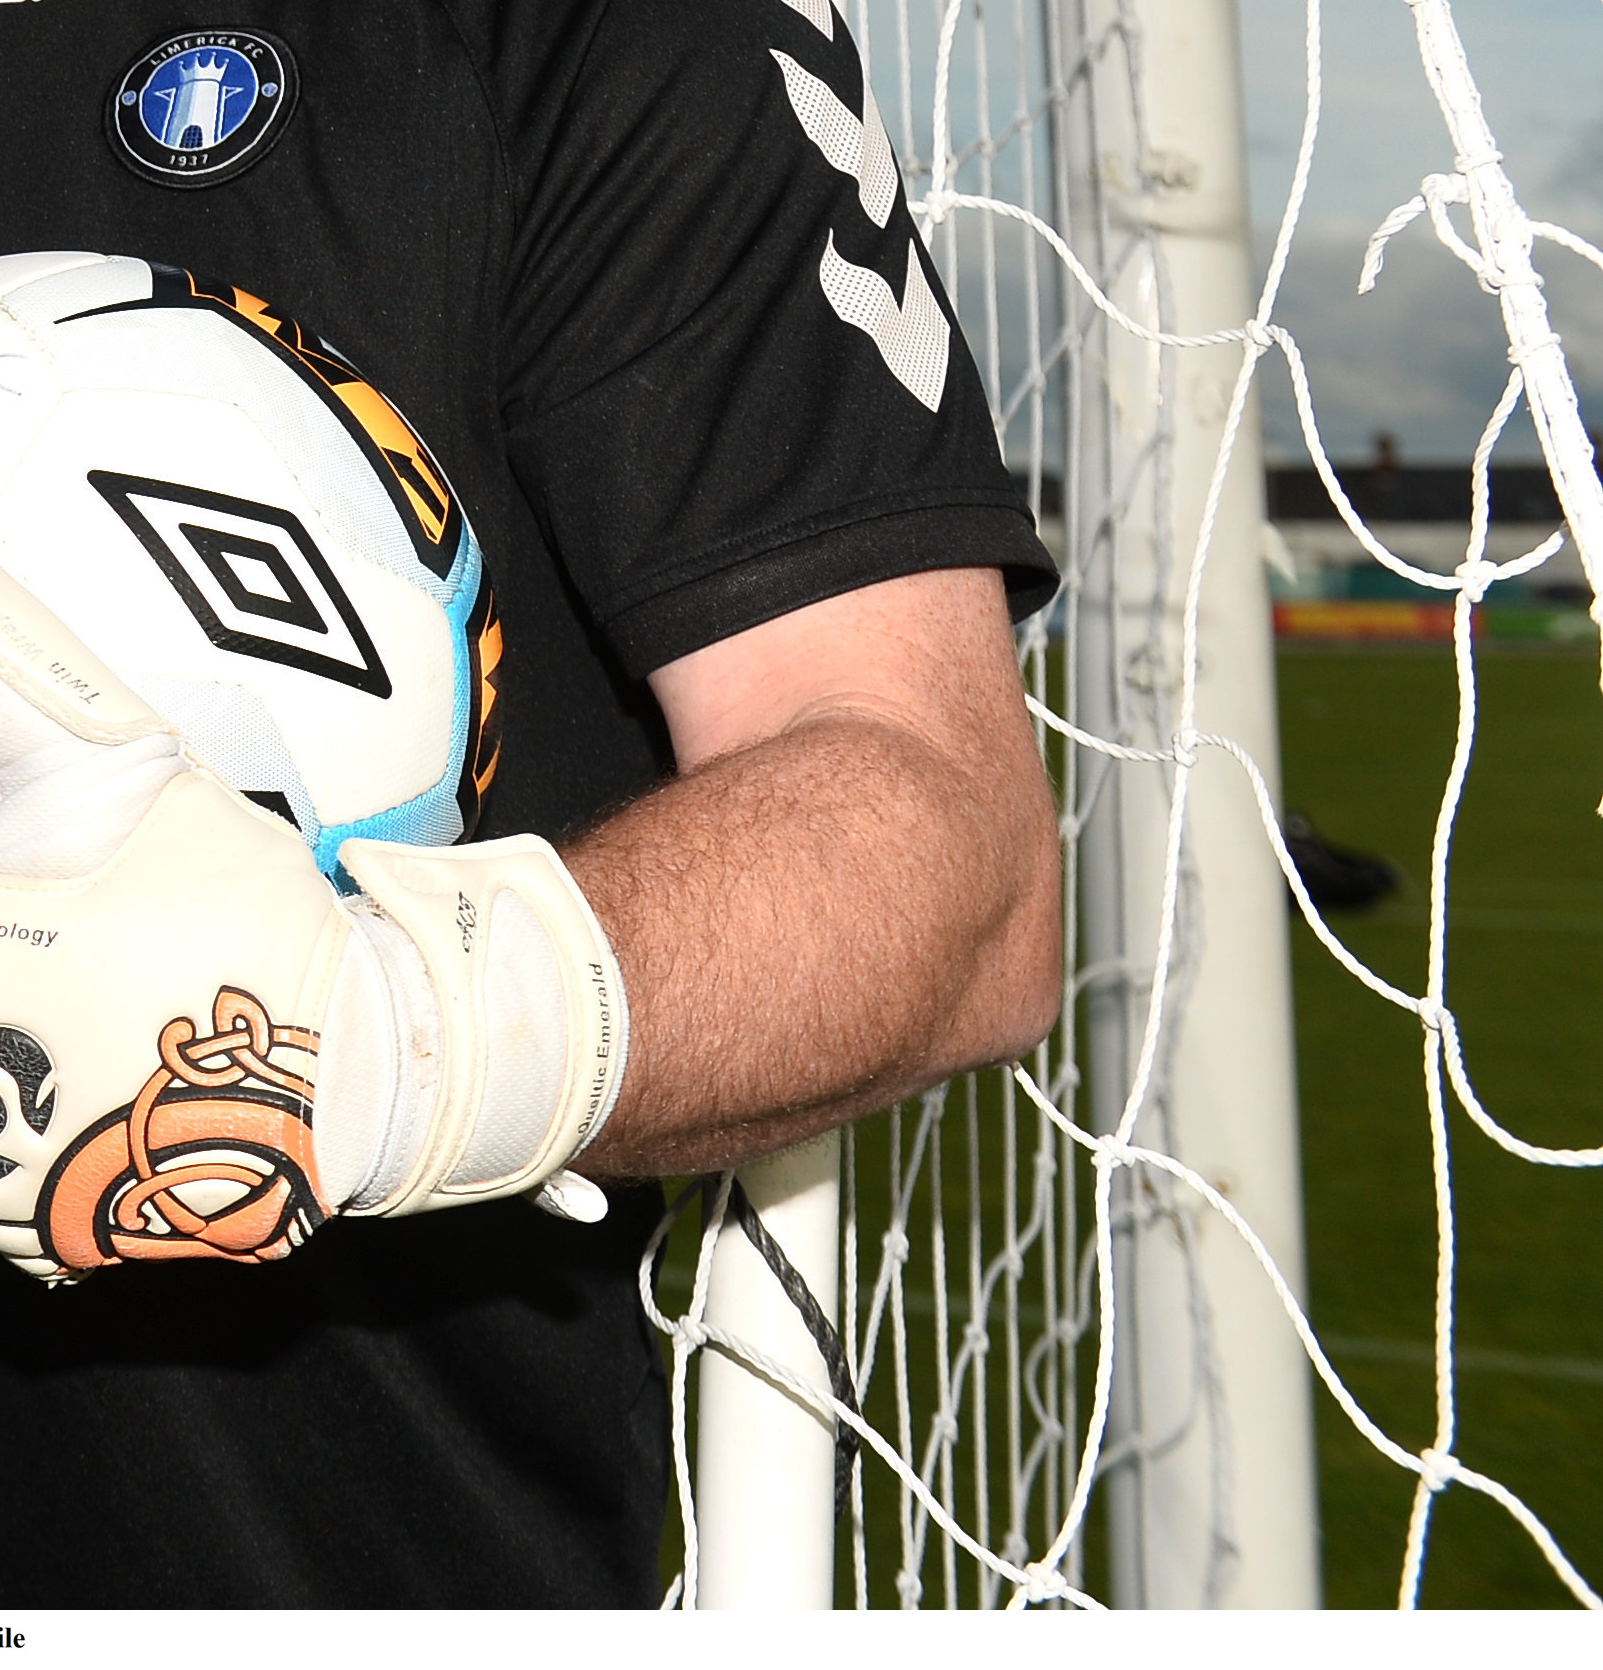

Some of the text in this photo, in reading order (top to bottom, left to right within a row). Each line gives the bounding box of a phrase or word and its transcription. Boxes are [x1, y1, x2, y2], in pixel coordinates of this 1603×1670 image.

[150, 36, 265, 67] LIMERICK FC
[169, 153, 210, 168] 1937
[48, 661, 101, 705] Twin
[588, 962, 612, 1059] Emerald
